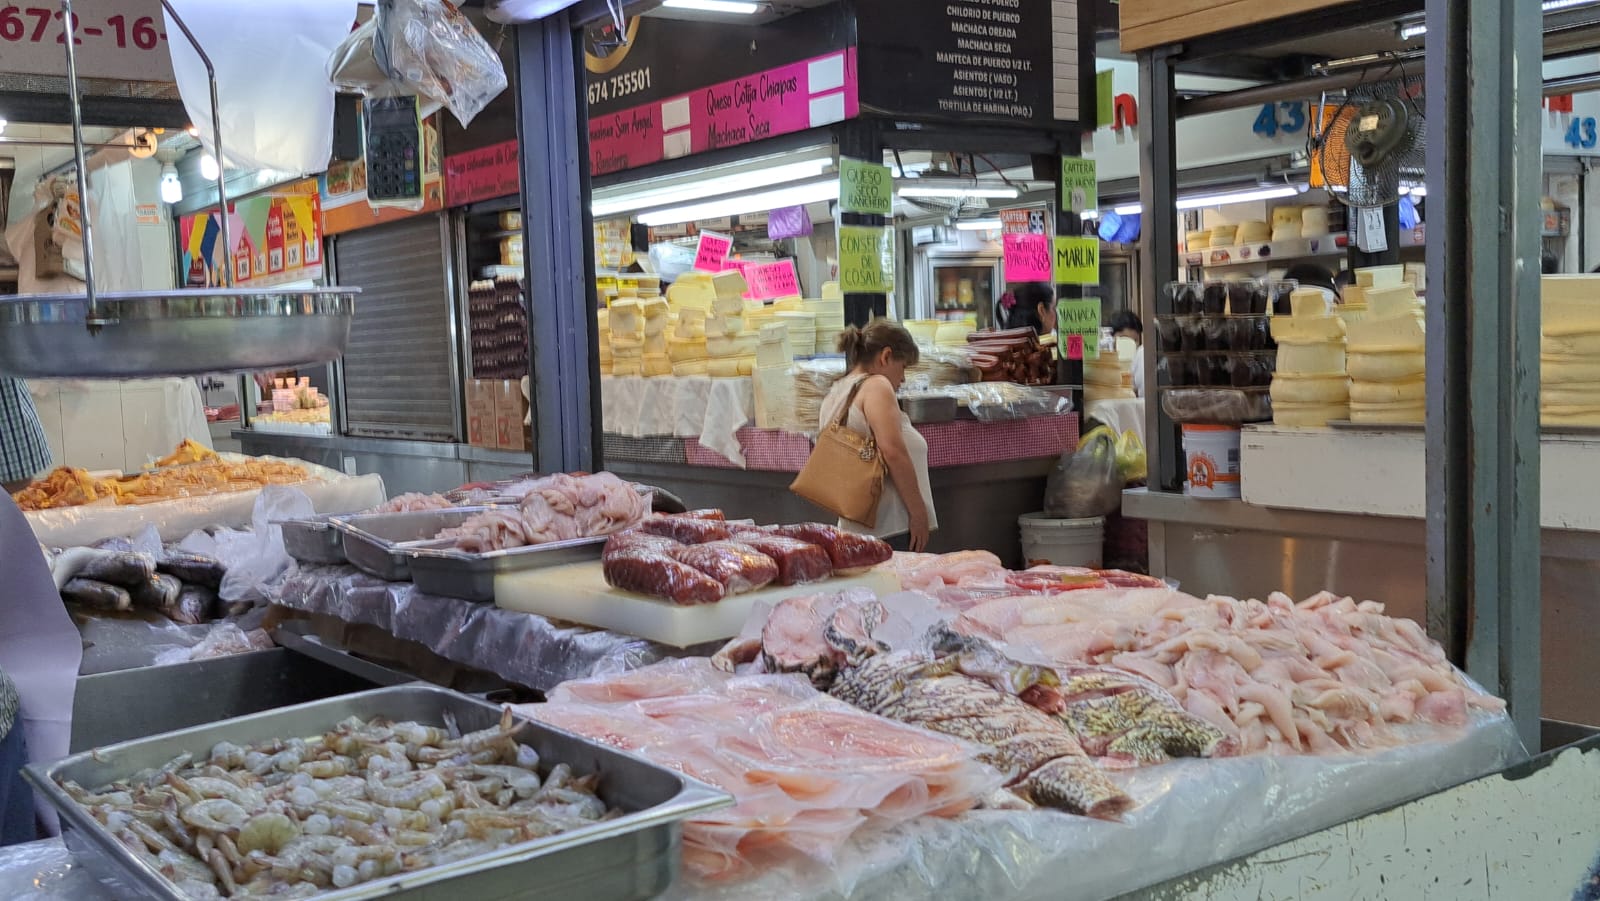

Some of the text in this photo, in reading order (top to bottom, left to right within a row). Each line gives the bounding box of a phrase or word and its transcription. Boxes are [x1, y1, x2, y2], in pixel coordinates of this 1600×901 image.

[946, 5, 1020, 24] CHILORIO DE PUERCO
[951, 22, 1017, 39] MACHACA OREADA
[957, 38, 1012, 54] MACHACA SECA
[936, 53, 1032, 71] MANTECA DE PUERCO 1/2 LT.
[588, 66, 651, 104] 674 755501
[953, 70, 988, 82] ASIENTOS
[706, 74, 797, 116] Queso Cotija Chiapas
[953, 85, 988, 98] ASIENTOS
[938, 99, 971, 112] TORTILLA
[972, 102, 982, 112] DE
[983, 103, 1010, 115] HARINA
[615, 114, 630, 138] San
[632, 108, 654, 138] Angel
[1252, 101, 1304, 137] 43
[708, 113, 770, 149] Machaca Seca
[1564, 117, 1597, 149] 43
[846, 168, 882, 185] QUESO
[855, 185, 879, 198] SECO
[848, 194, 889, 209] RANCHERO
[1057, 245, 1095, 268] MARLIN
